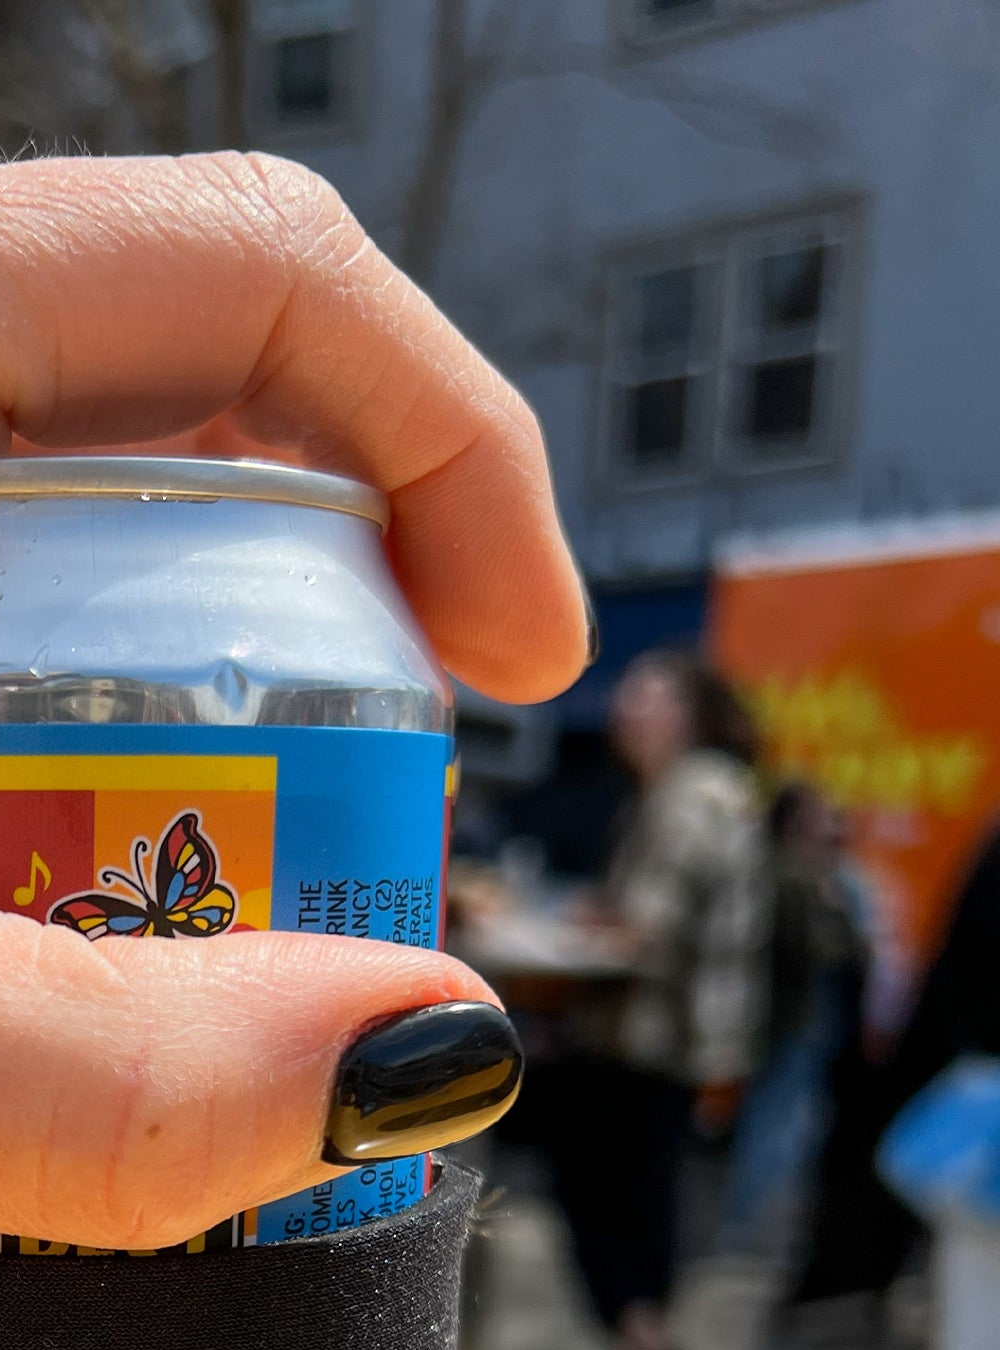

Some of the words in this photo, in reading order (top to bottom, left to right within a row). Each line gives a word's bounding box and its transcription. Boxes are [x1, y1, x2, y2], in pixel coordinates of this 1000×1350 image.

[298, 880, 322, 928] THE
[375, 879, 393, 911] (2)
[393, 879, 409, 943] PAIRS
[310, 1180, 333, 1237] OME
[326, 879, 348, 934] RINK
[395, 1175, 407, 1211] IVE
[409, 878, 423, 946] ERATE
